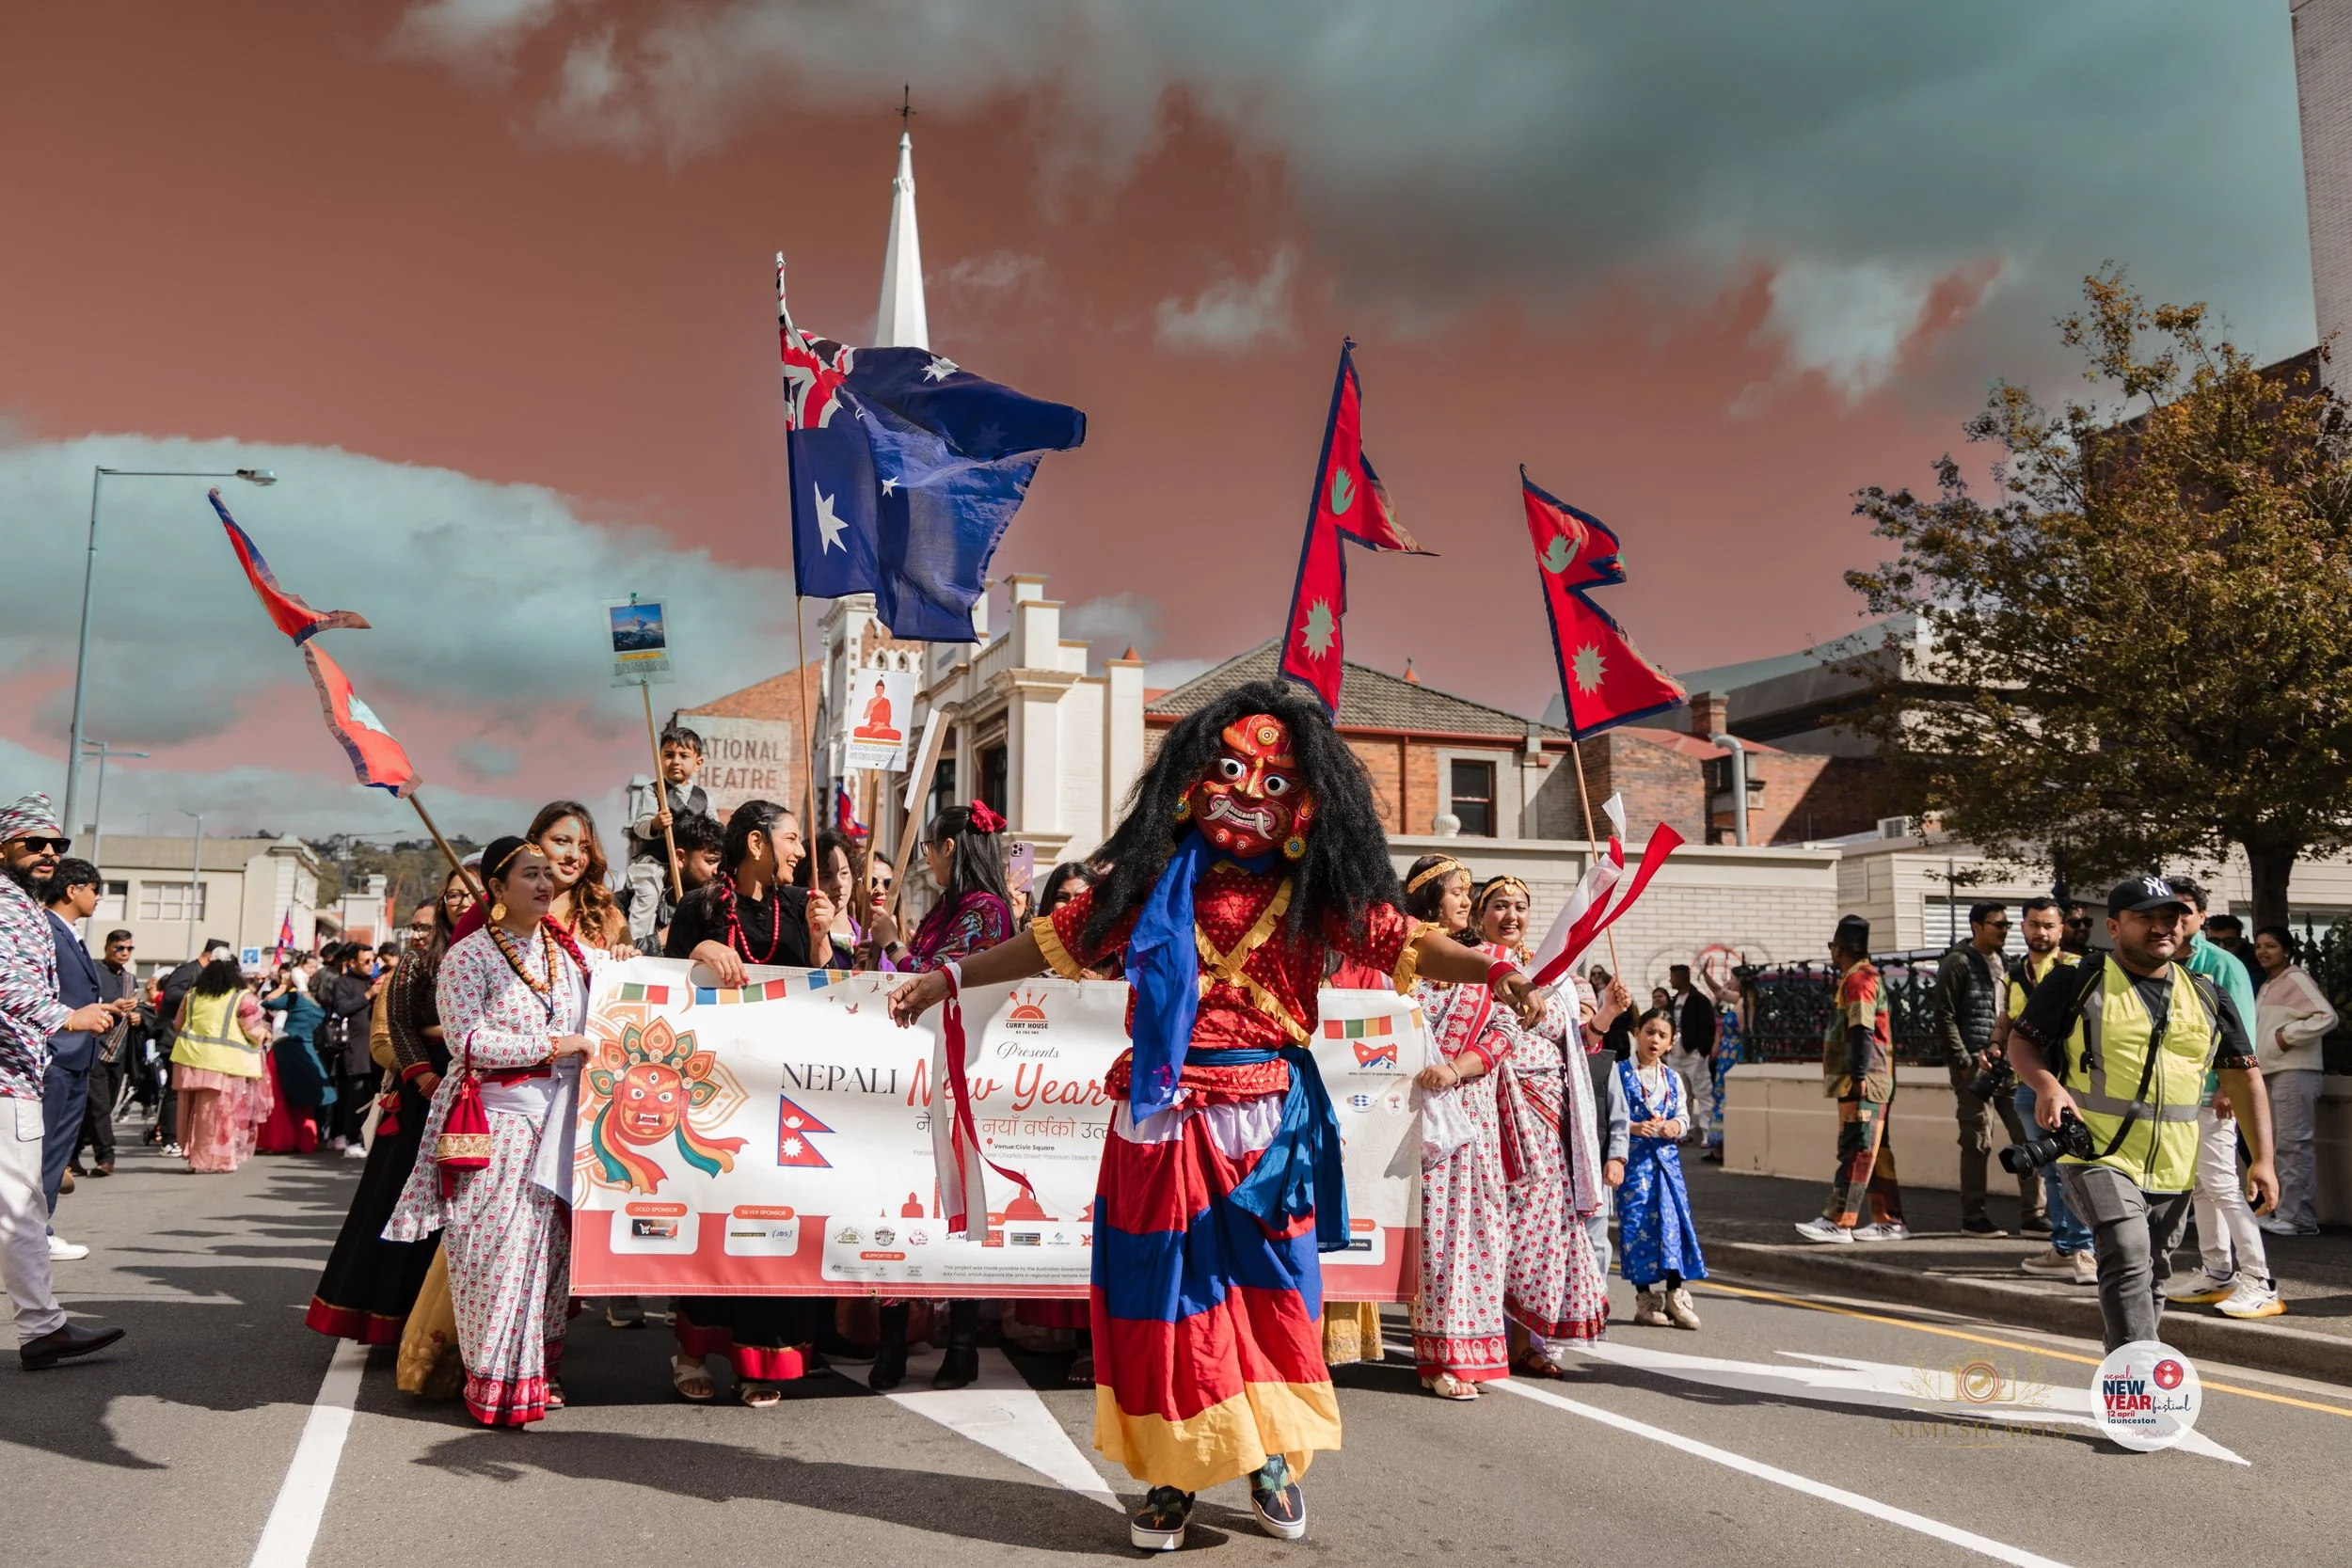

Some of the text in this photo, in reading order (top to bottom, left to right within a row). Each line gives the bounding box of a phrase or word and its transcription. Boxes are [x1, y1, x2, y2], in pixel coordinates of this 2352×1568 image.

[700, 736, 783, 762] ATIONAL
[697, 766, 777, 790] HEATRE
[2143, 877, 2169, 896] NY
[997, 1040, 1060, 1060] Presents
[781, 1062, 897, 1095] NEPALI
[1011, 1062, 1108, 1111] Year
